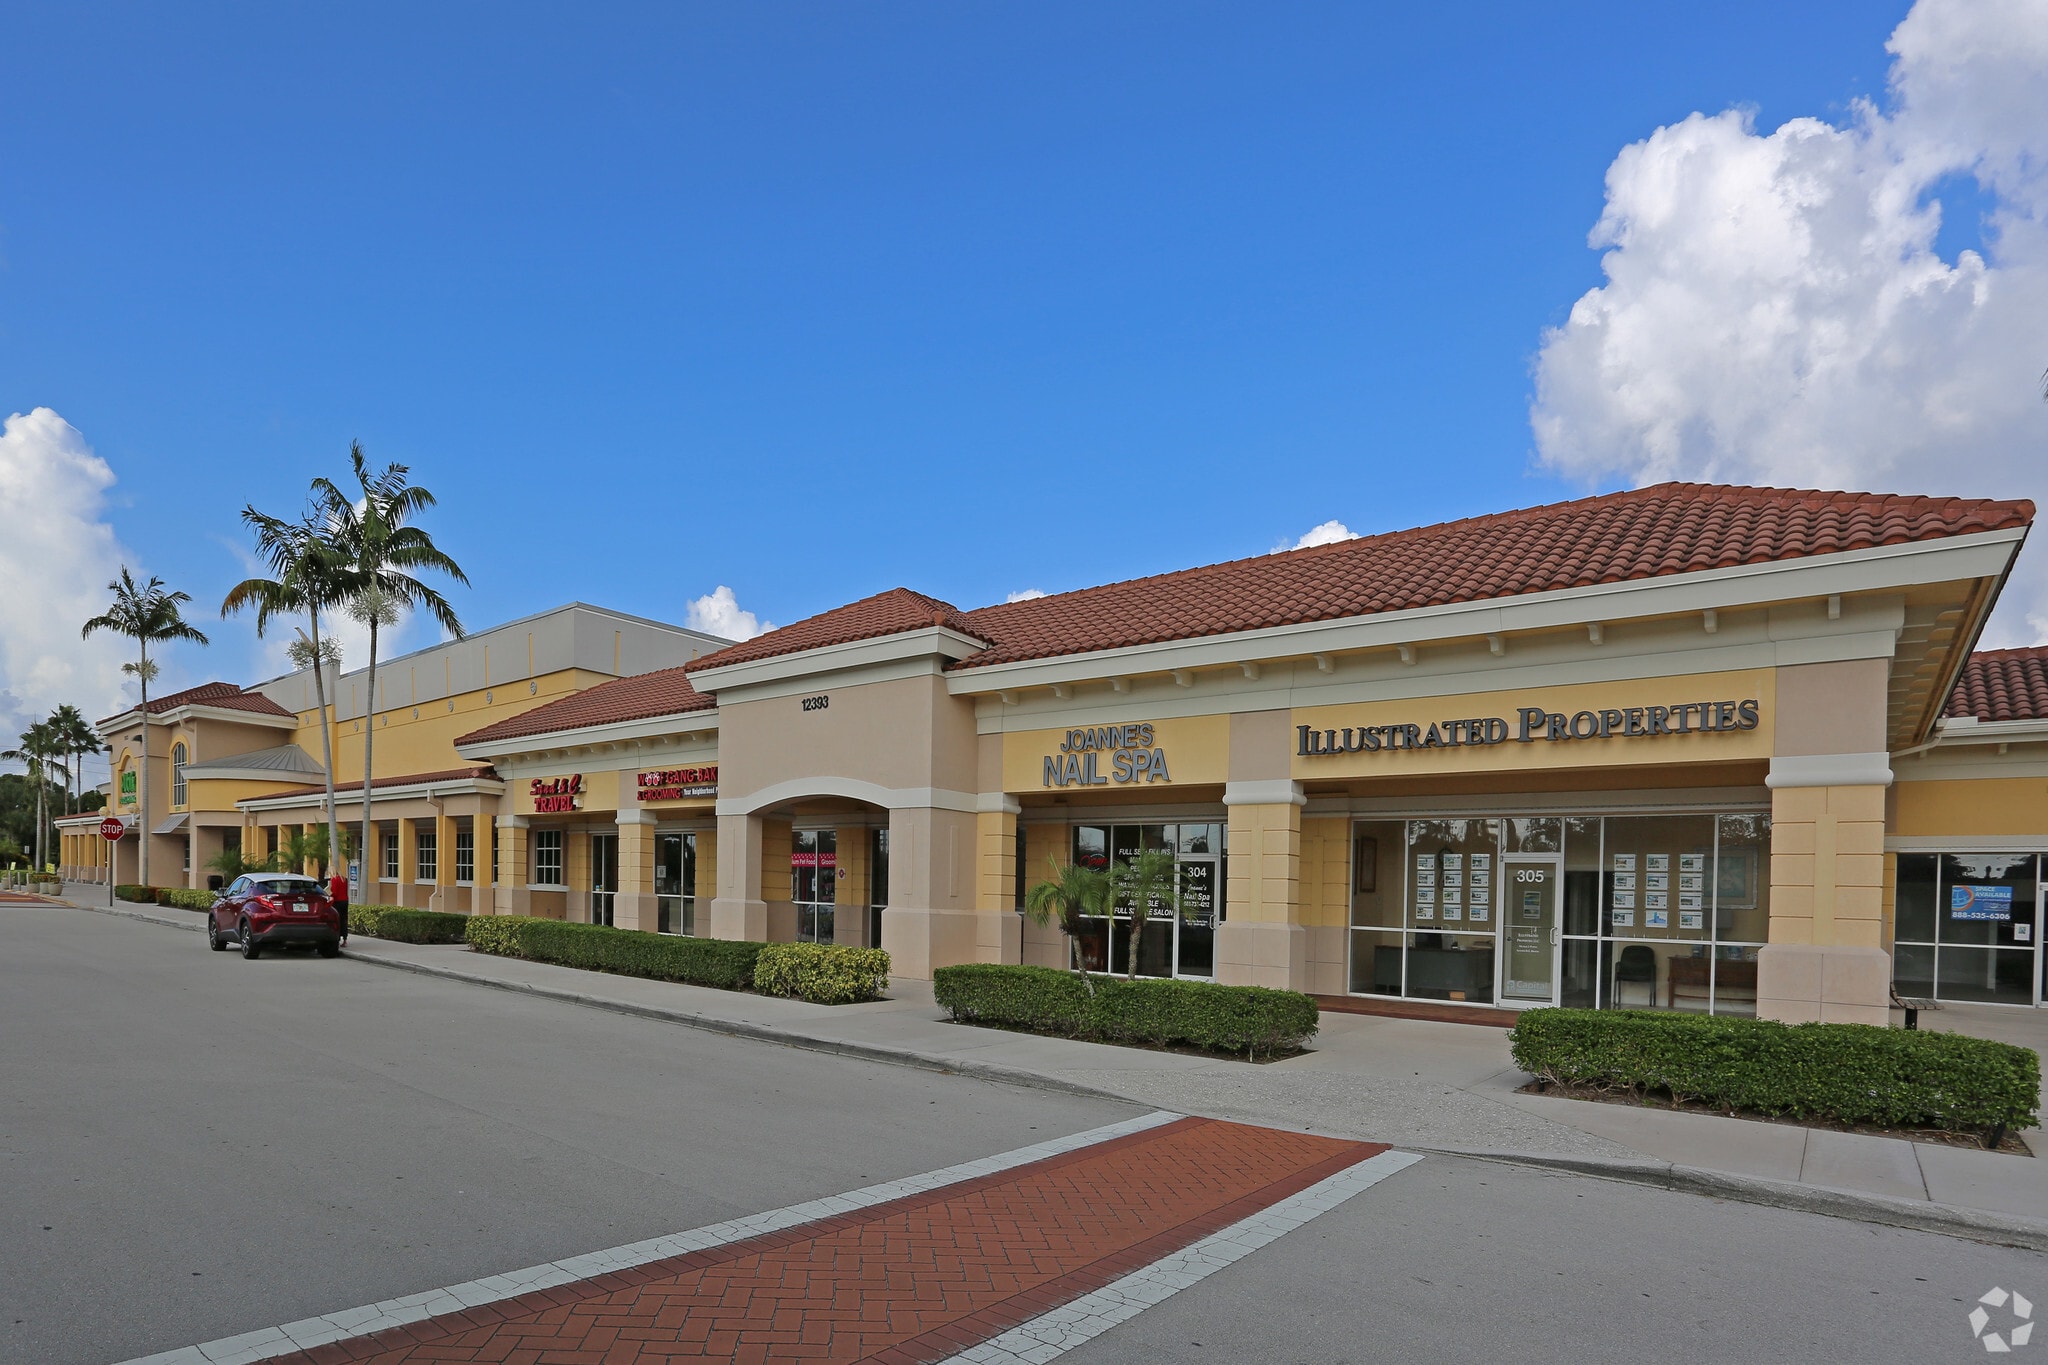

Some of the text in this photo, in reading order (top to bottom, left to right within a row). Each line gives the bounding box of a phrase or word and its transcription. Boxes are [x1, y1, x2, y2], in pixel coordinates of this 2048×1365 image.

[801, 695, 829, 711] 12393
[1296, 699, 1759, 756] ILLUSTRATED PROPERTIES
[1060, 723, 1154, 753] JOANNE'S
[1043, 748, 1171, 787] NAIL SPA
[666, 768, 697, 784] GANG
[637, 790, 642, 800] &
[642, 788, 682, 800] GROOMING
[534, 795, 576, 813] TRAVEL
[101, 824, 122, 834] STOP
[1187, 866, 1207, 878] 304
[1516, 869, 1544, 883] 305
[1198, 892, 1210, 902] Spa
[1153, 908, 1174, 916] SALON
[1952, 911, 2010, 920] 888-535-6306
